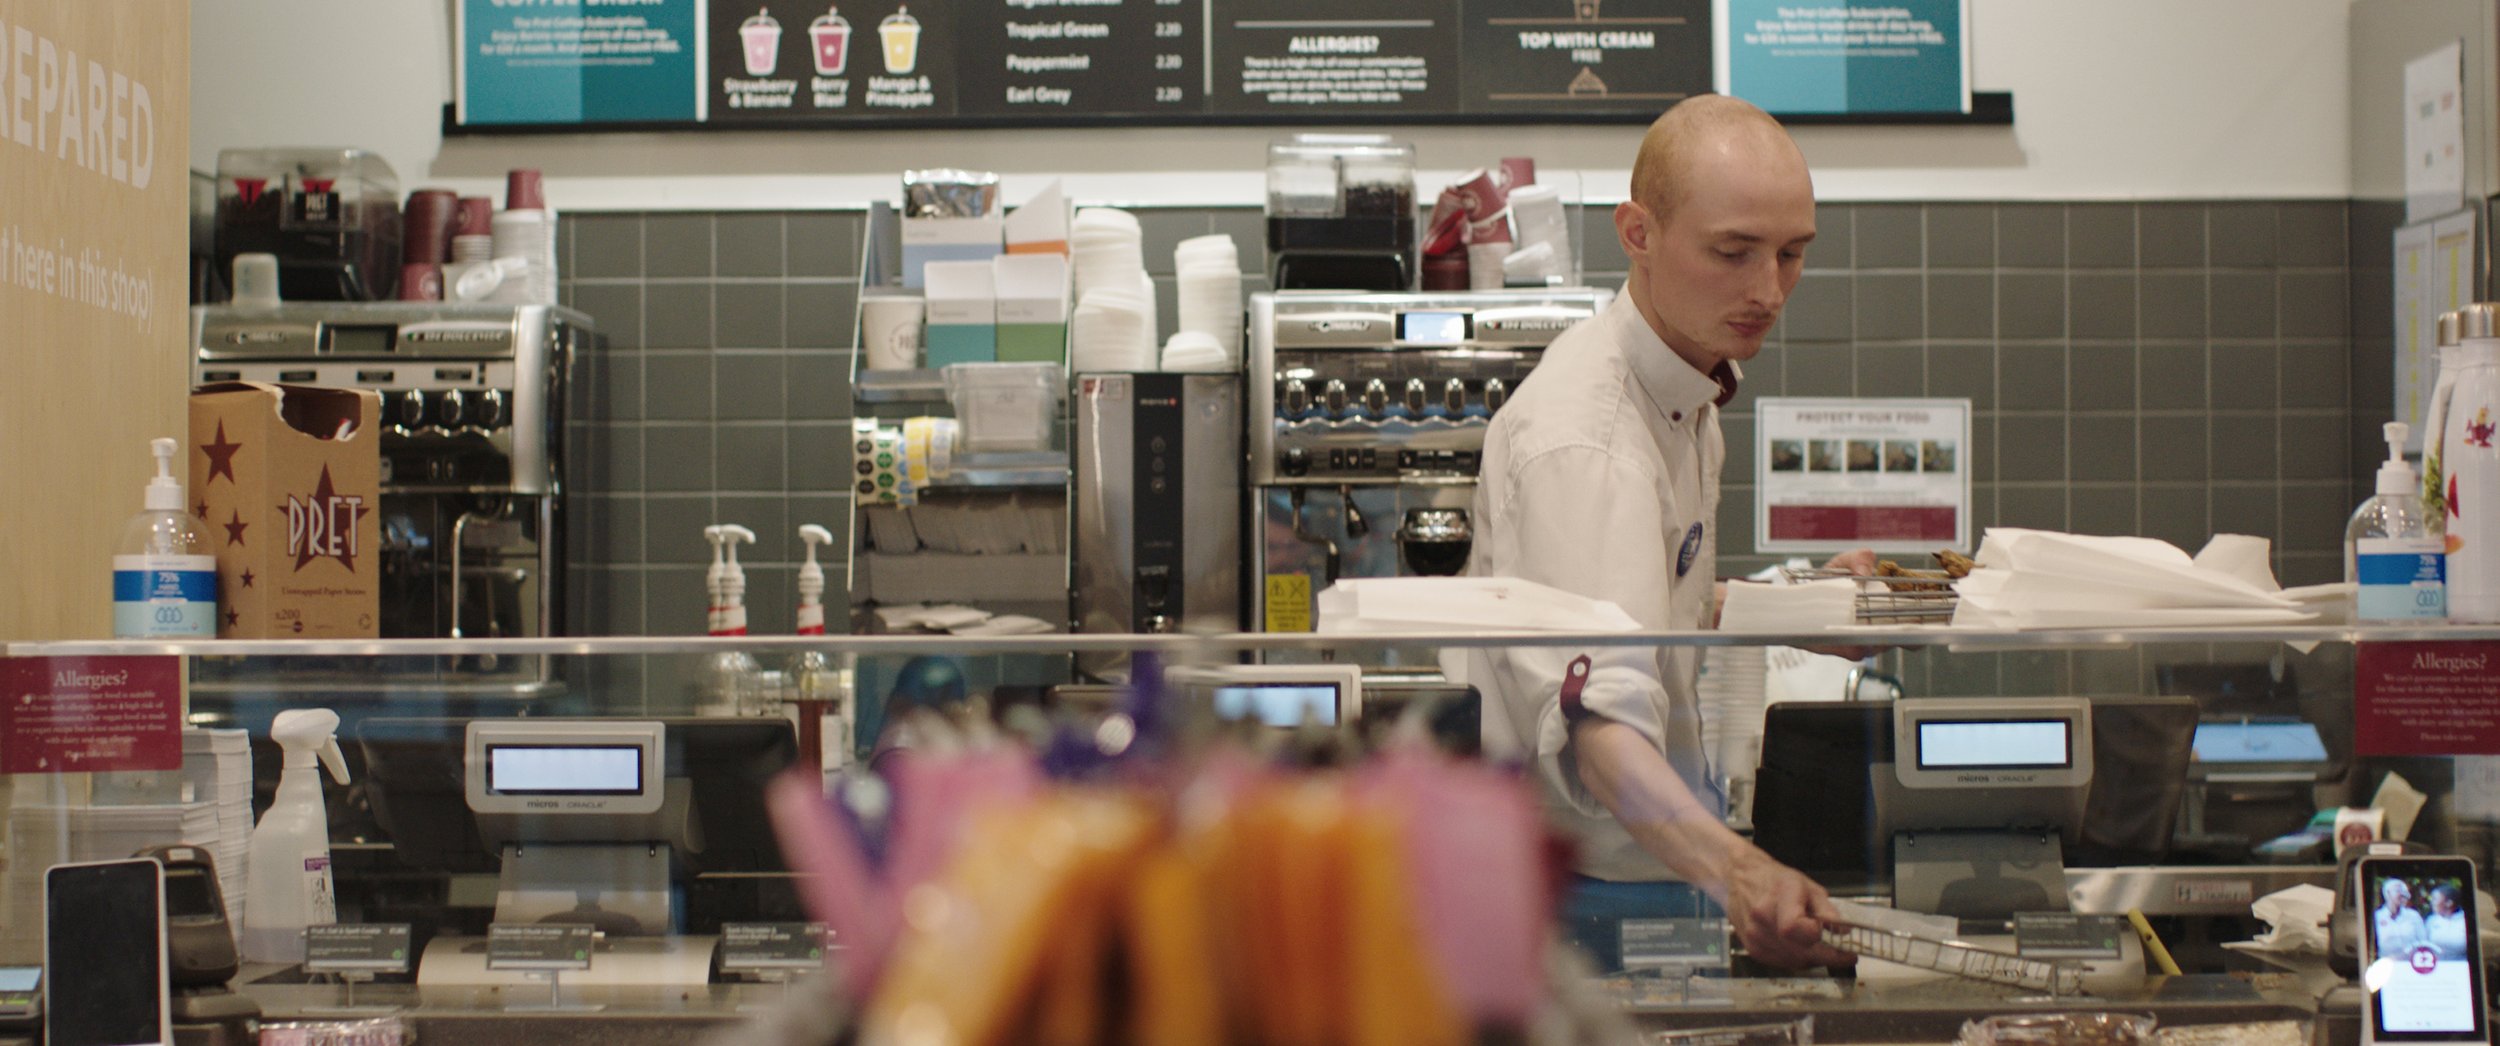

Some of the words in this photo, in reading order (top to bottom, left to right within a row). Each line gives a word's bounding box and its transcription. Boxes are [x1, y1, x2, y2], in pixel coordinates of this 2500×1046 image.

[1006, 21, 1063, 40] Tropical
[1064, 21, 1110, 37] Green
[1289, 35, 1380, 53] ALLERGIES?
[1519, 32, 1551, 48] TOP
[1552, 32, 1597, 48] WITH
[1599, 32, 1655, 48] CREAM
[1006, 54, 1090, 73] Peppermint
[1571, 50, 1601, 62] FREE
[723, 77, 798, 95] Strawberry
[811, 76, 850, 93] Berry
[868, 76, 917, 94] Mango
[918, 75, 931, 91] &
[729, 93, 741, 108] &
[743, 93, 792, 108] Banana
[865, 91, 934, 109] Pineapple
[1006, 86, 1034, 103] Earl
[1035, 86, 1072, 106] Grey
[13, 224, 55, 294] here
[60, 237, 75, 299] in
[79, 247, 108, 310] this
[1796, 411, 1854, 424] PROTECT
[1858, 411, 1892, 424] YOUR
[1897, 411, 1930, 424] FOOD
[288, 495, 364, 557] PRET
[2412, 652, 2487, 673] Allergies?
[54, 670, 128, 689] Allergies?
[1957, 774, 1990, 783] micros
[527, 799, 559, 808] micros
